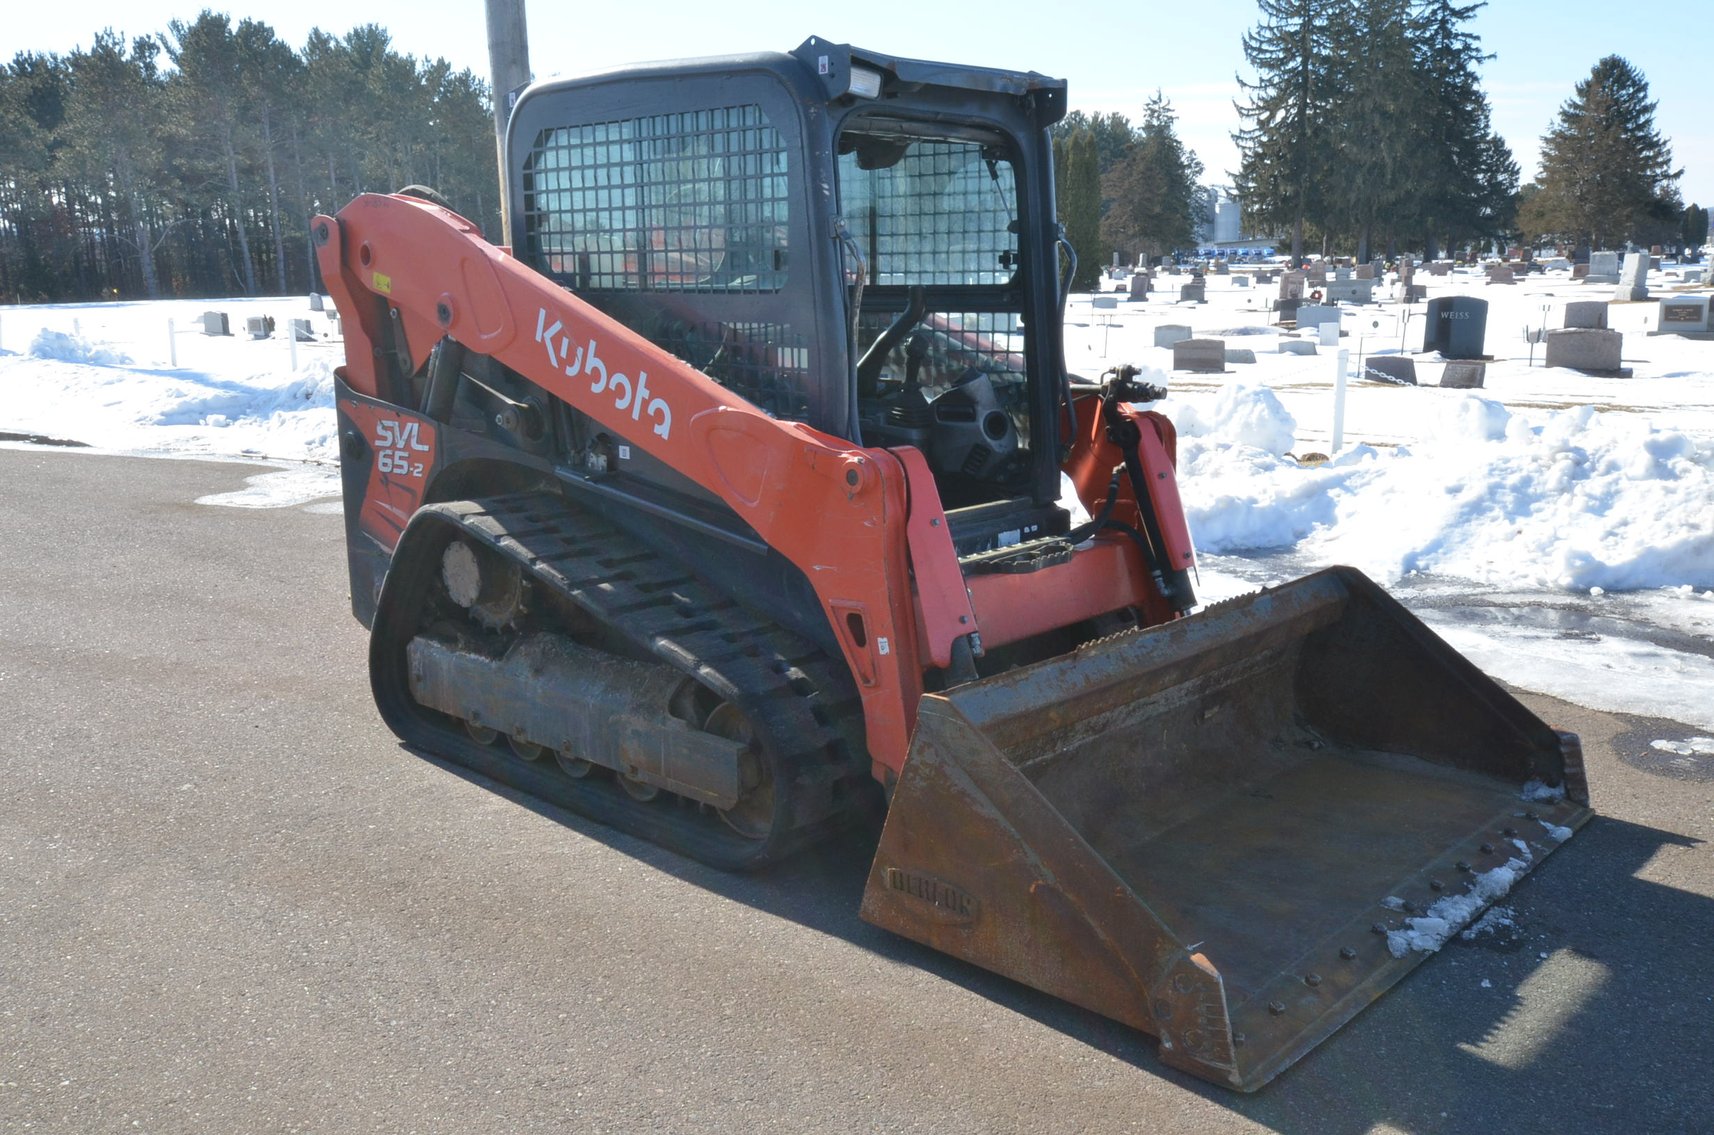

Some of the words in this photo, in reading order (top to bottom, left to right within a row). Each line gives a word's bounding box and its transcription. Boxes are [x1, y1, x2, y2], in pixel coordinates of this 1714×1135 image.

[1440, 311, 1471, 320] WEISS
[535, 307, 672, 441] Kubota
[375, 420, 430, 452] SVL
[378, 449, 424, 478] 65-2
